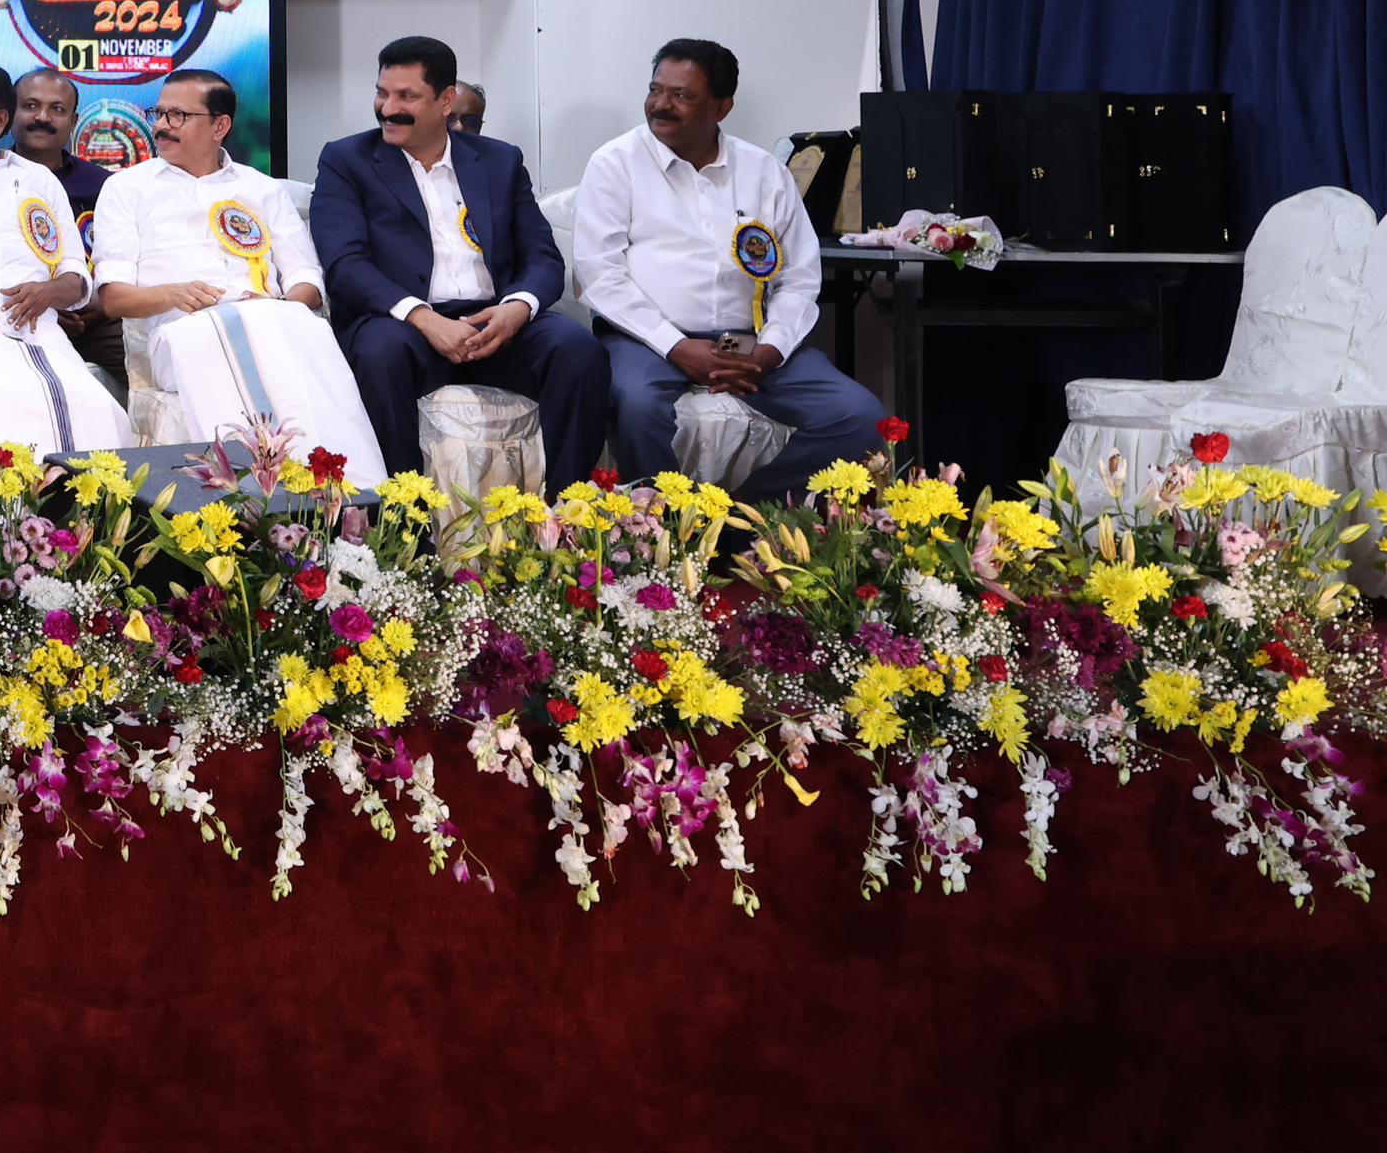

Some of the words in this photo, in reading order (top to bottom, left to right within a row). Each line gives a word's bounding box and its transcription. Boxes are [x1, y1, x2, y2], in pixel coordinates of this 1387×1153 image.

[94, 0, 183, 32] 2024
[61, 44, 95, 70] 01
[100, 39, 173, 56] NOVEMBER
